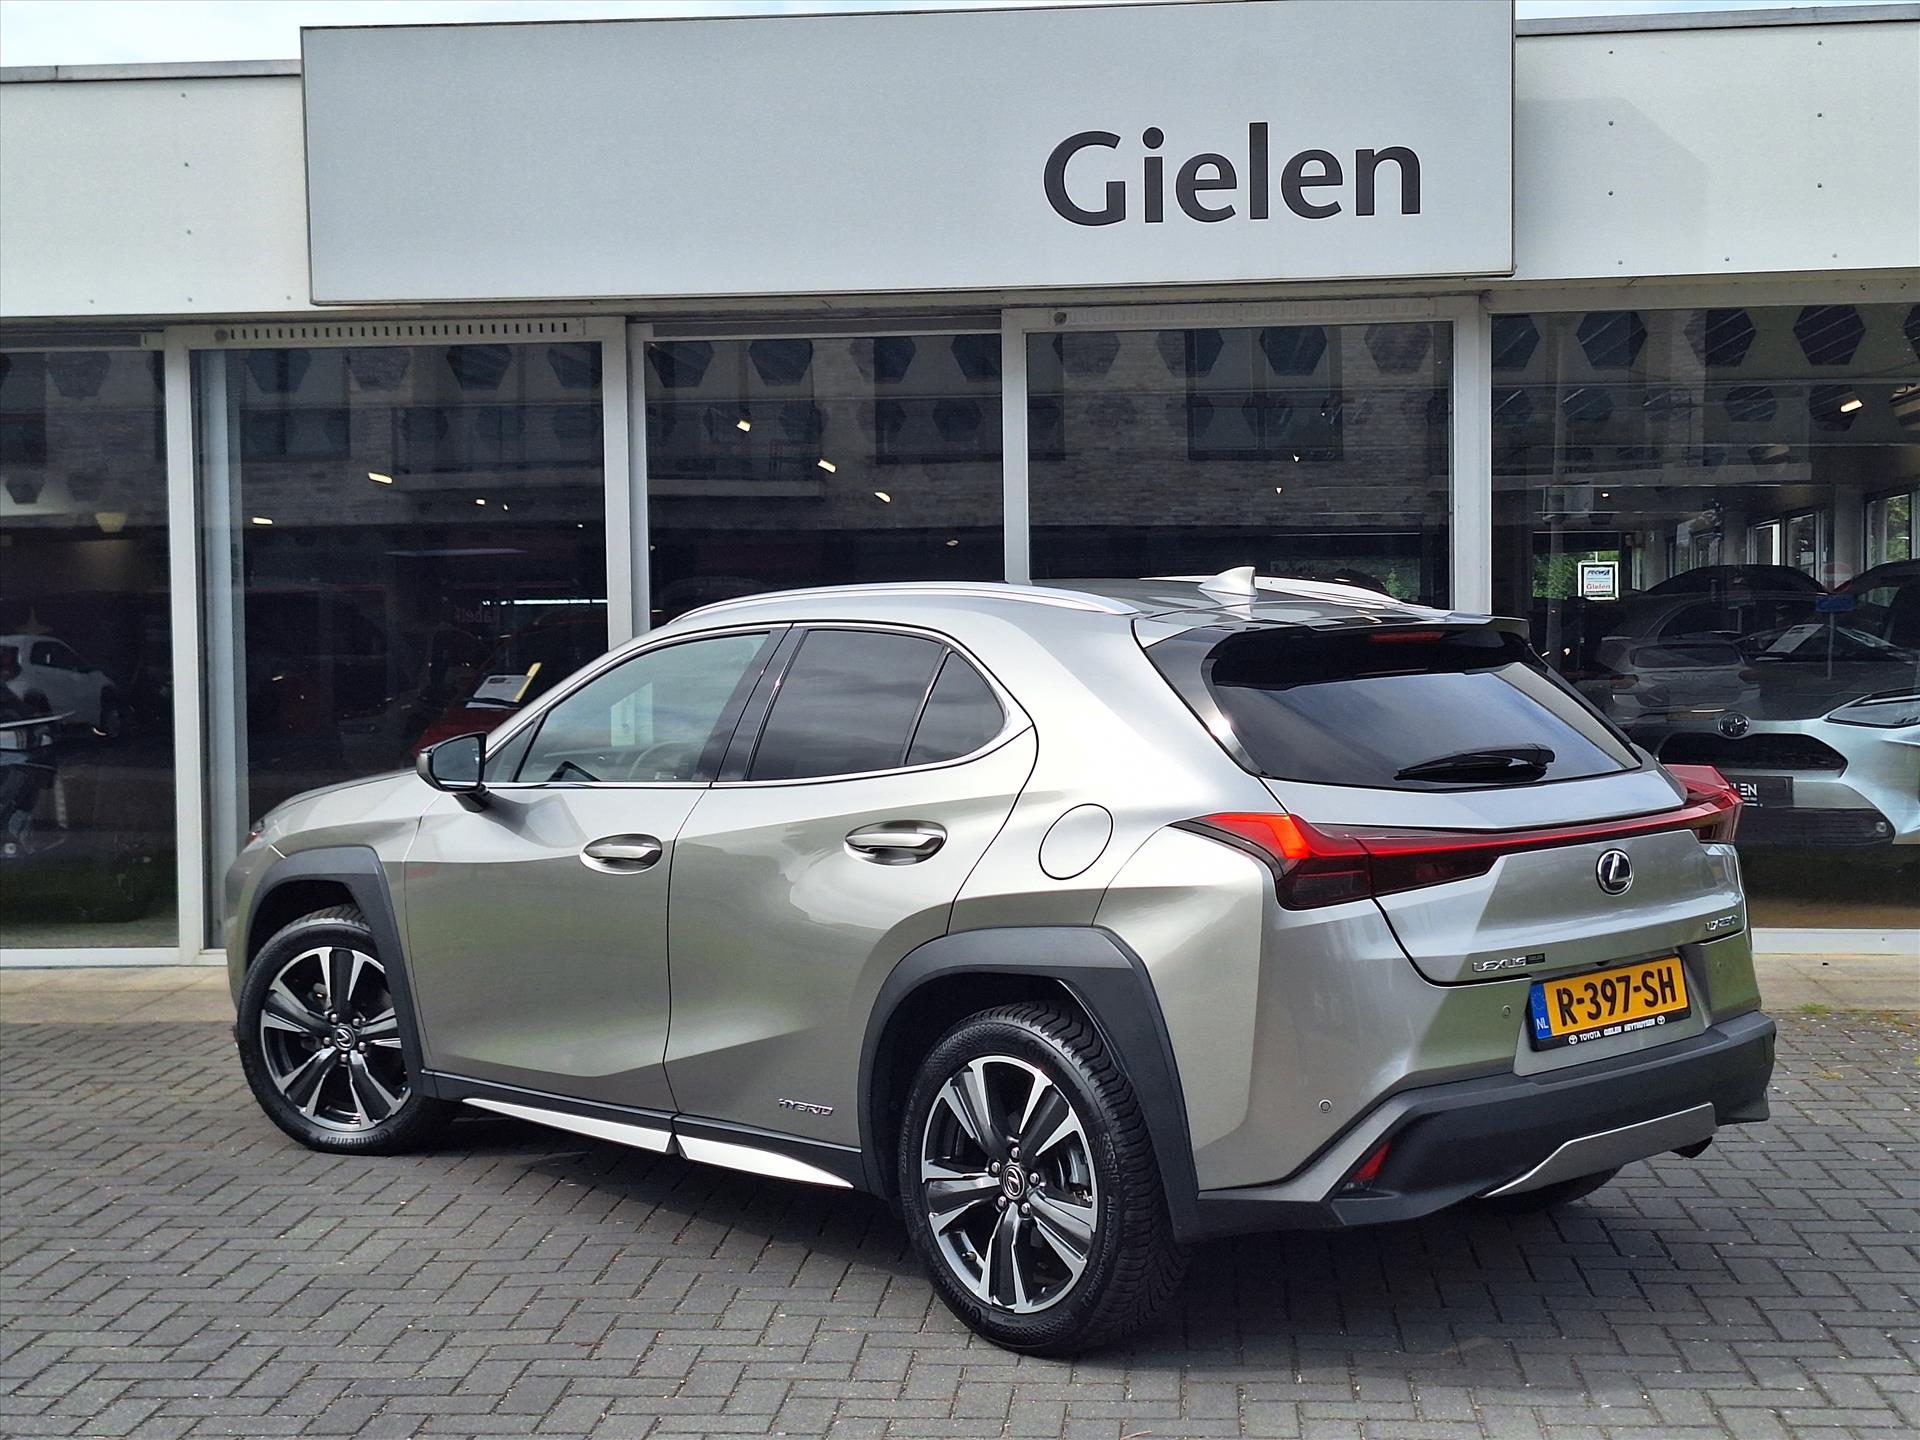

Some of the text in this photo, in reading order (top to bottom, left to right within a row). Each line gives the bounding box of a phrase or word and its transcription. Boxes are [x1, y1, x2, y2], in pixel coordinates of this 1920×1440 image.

[1044, 122, 1420, 226] Gielen
[1472, 957, 1526, 973] LEXUS
[1556, 966, 1677, 1027] R-397-SH
[1536, 1017, 1550, 1030] NL
[1579, 1030, 1601, 1042] TOYOTA
[778, 1098, 833, 1116] HYBRID
